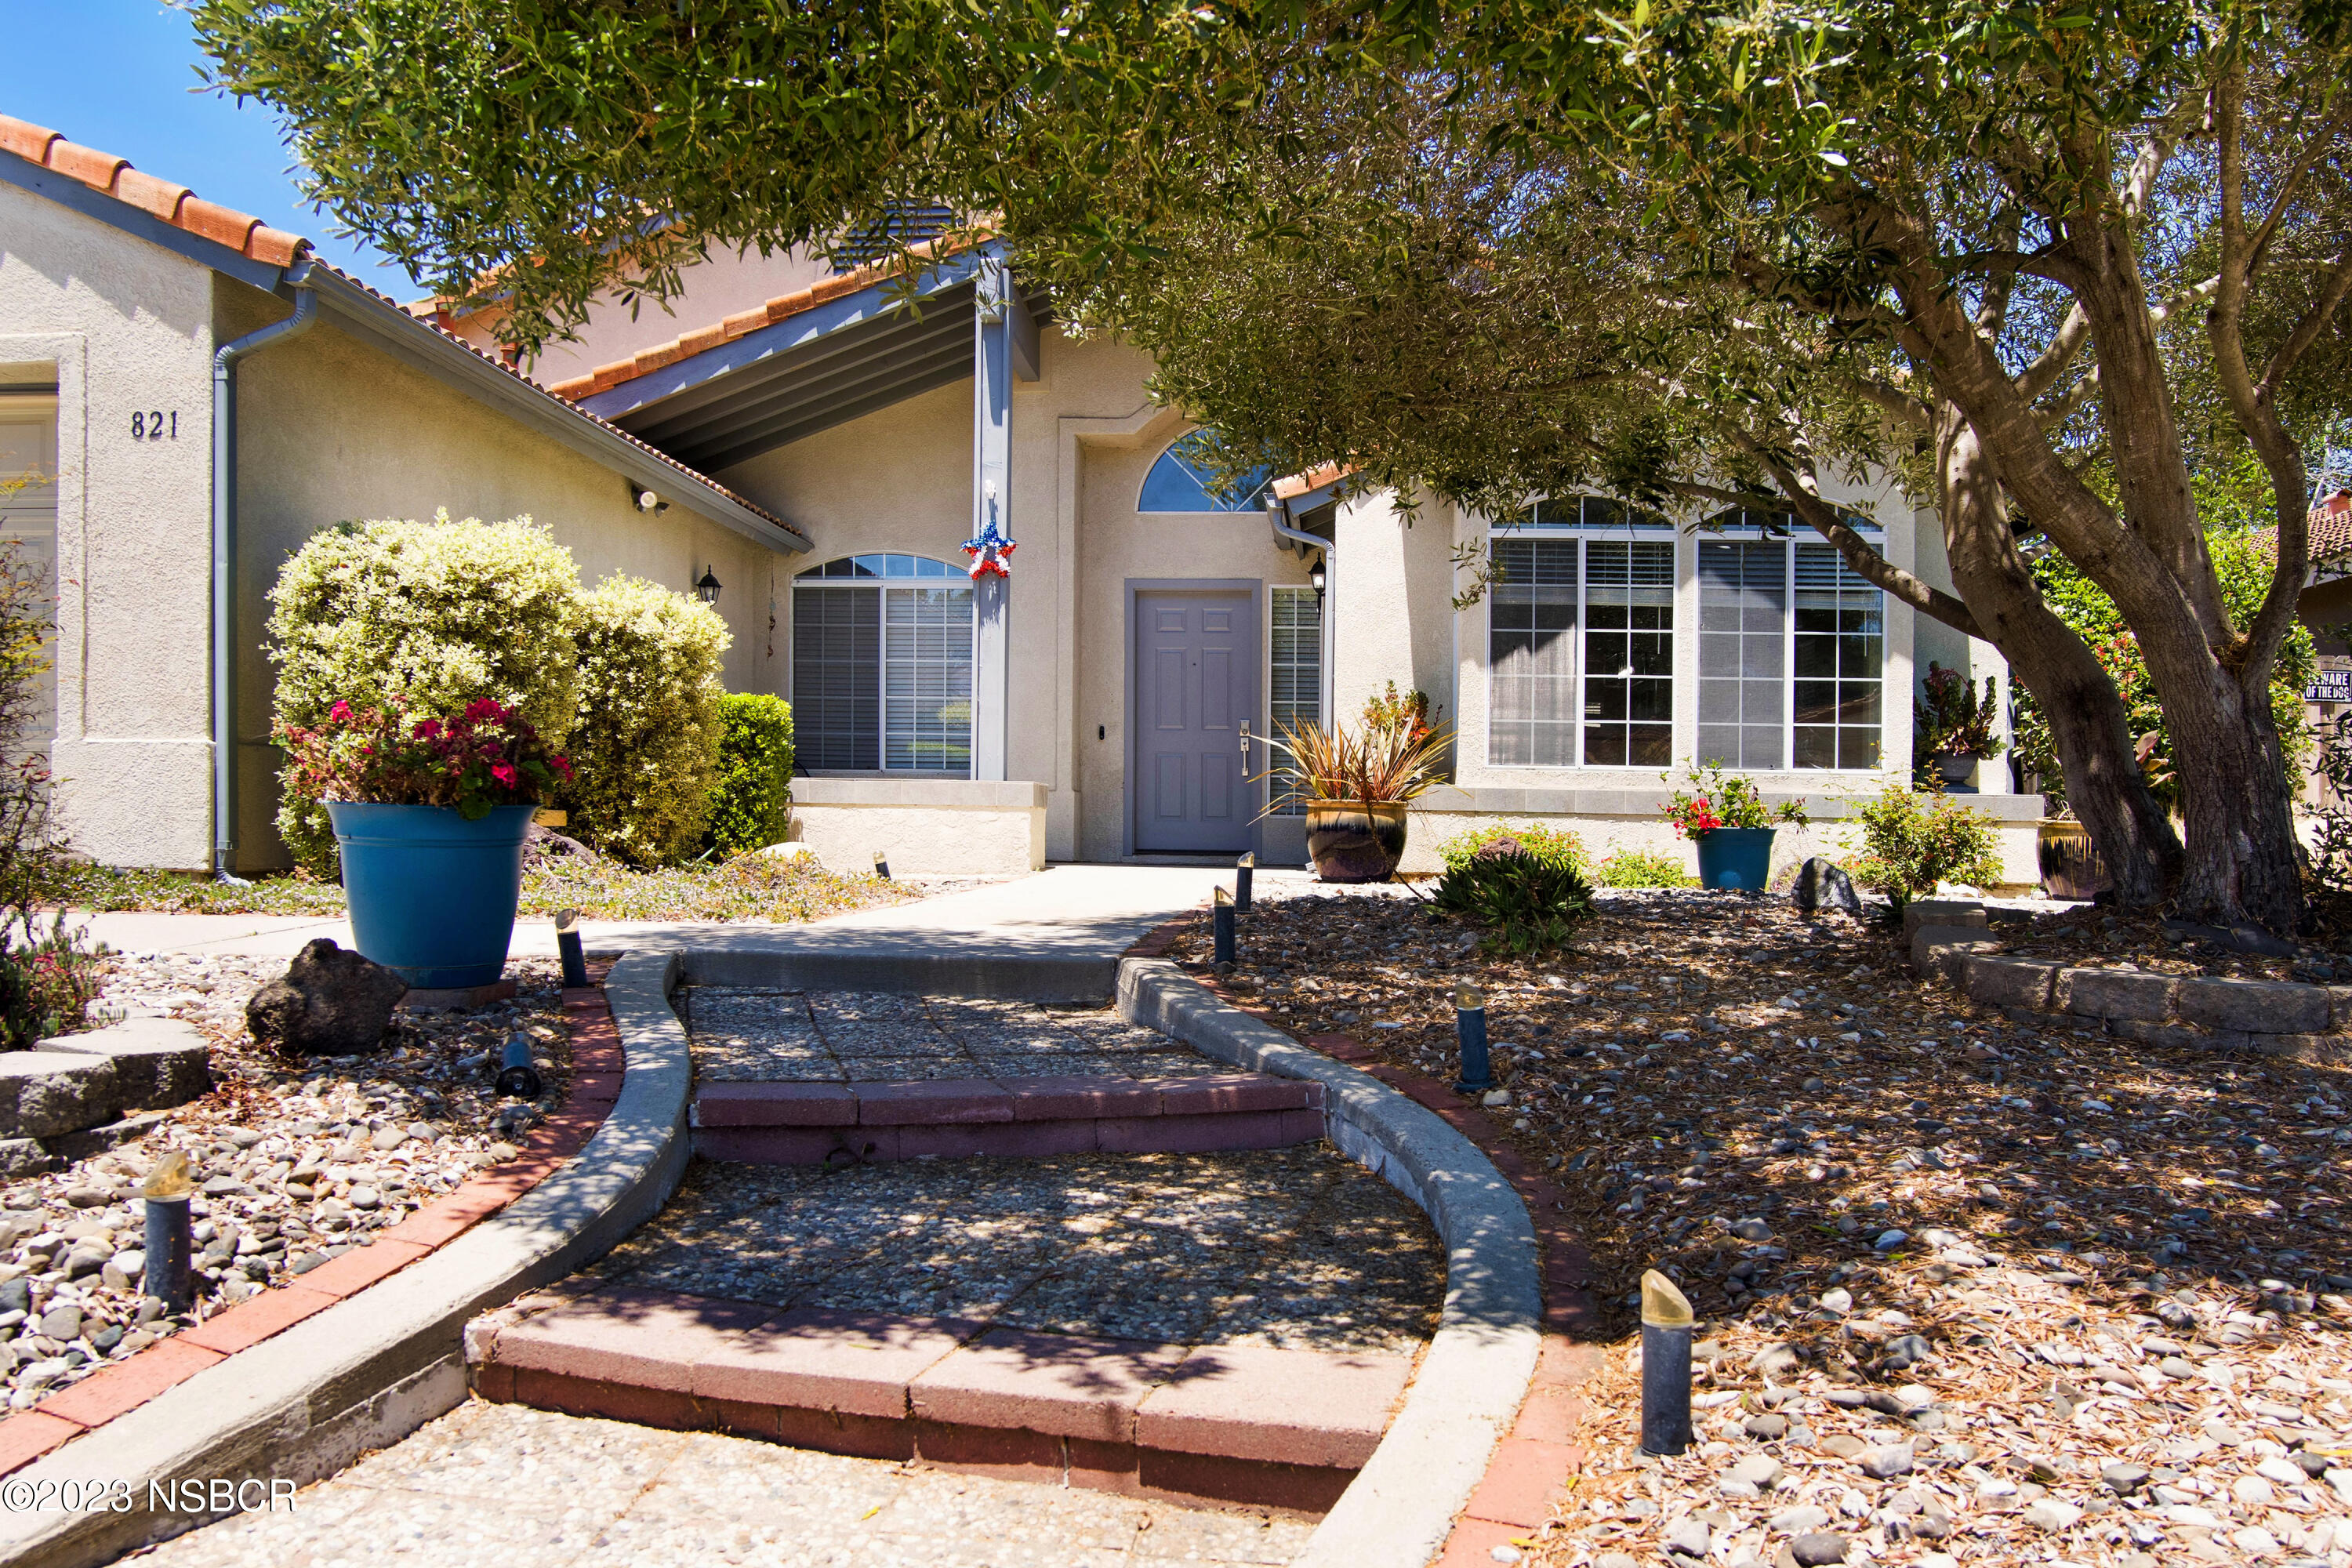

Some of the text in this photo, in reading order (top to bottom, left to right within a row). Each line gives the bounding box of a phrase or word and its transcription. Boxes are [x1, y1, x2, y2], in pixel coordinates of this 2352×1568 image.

[132, 410, 177, 438] 821
[2306, 686, 2350, 699] OF THE DOG
